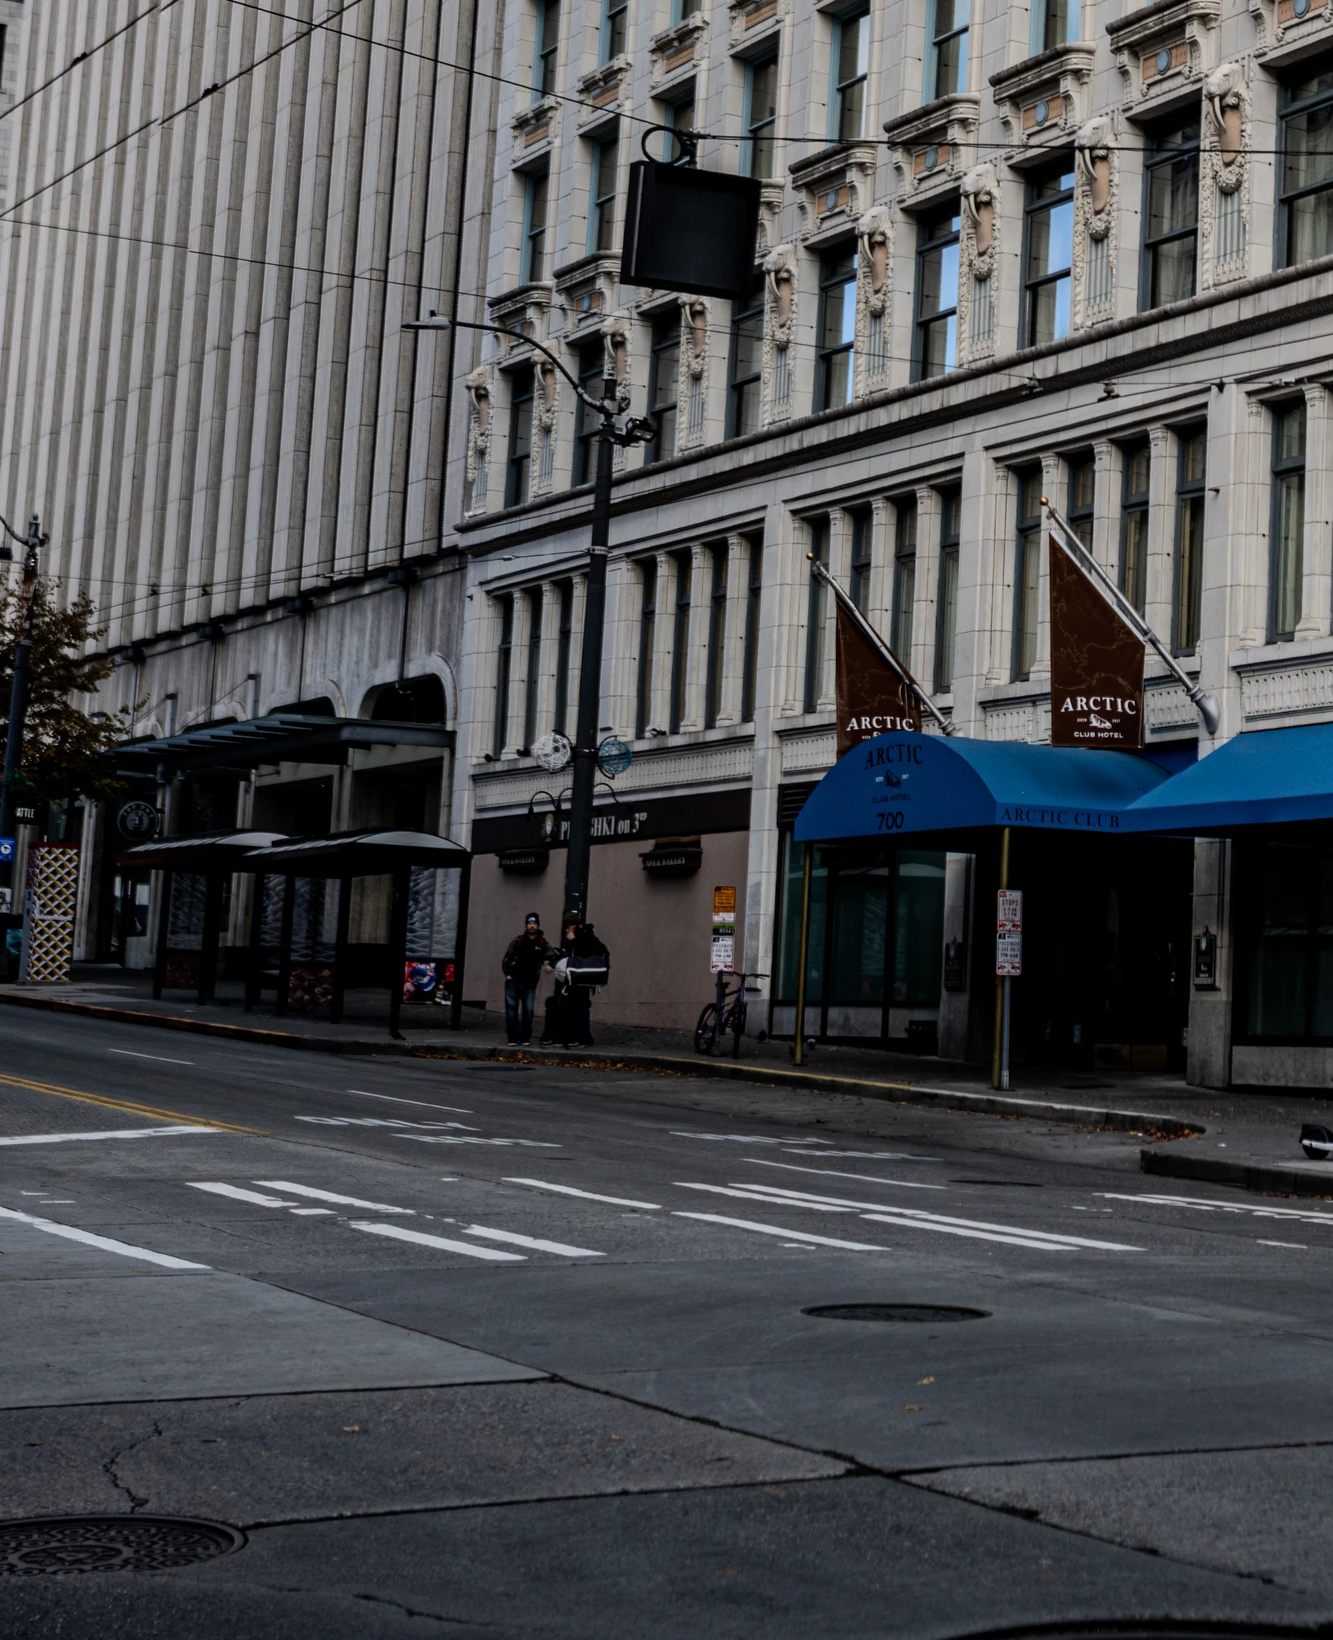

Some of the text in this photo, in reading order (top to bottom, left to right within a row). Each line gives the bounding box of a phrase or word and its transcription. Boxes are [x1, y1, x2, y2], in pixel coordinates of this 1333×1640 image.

[1060, 696, 1137, 715] ARCTIC
[846, 716, 915, 732] ARCTIC
[864, 743, 923, 770] ARCTIC
[872, 795, 889, 804] CLUB
[618, 819, 630, 835] on
[877, 811, 905, 831] 700
[1002, 807, 1119, 828] ARCTIC CLUB
